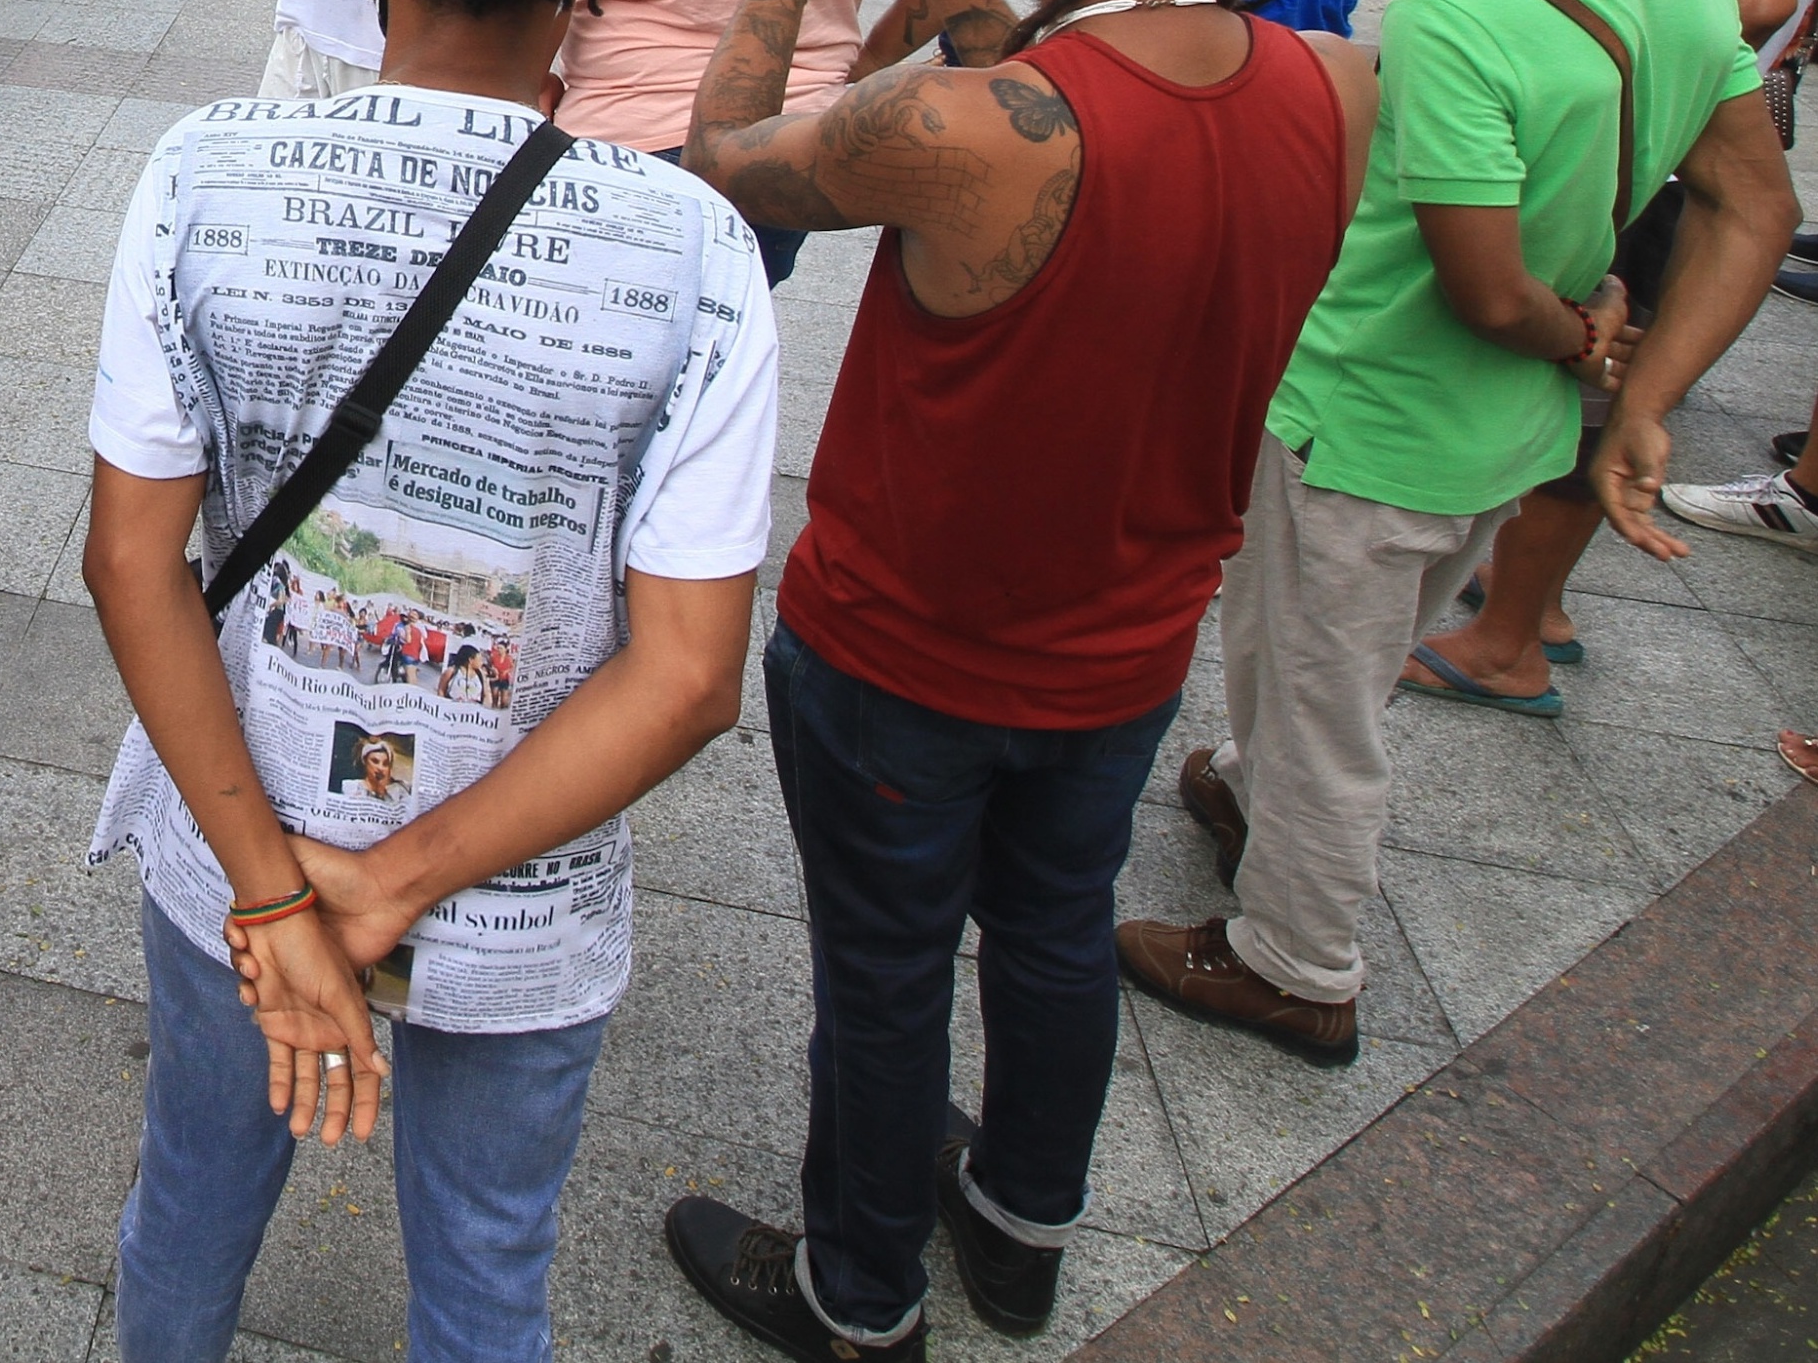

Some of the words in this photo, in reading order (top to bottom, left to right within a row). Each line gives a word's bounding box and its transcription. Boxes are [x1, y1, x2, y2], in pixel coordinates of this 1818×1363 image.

[199, 94, 422, 127] BRAZIL
[456, 108, 646, 177] LIRE
[268, 140, 386, 181] GAZETA
[399, 154, 439, 189] DE
[449, 162, 600, 214] NOCIAS
[282, 196, 425, 239] BRAZIL
[192, 227, 244, 249] 1888
[609, 287, 670, 314] 1888
[315, 236, 398, 263] TREZE
[408, 248, 445, 268] DE
[478, 262, 528, 287] AIO
[264, 257, 382, 287] EXTINCÇÃO
[394, 271, 421, 291] DA
[464, 285, 580, 325] CRAVIDÃO
[211, 285, 247, 298] LEI
[248, 290, 274, 302] N.
[282, 294, 335, 308] 3353
[343, 296, 376, 310] DE
[385, 300, 409, 312] 13
[462, 315, 528, 341] MAIO
[538, 334, 574, 351] DE
[580, 342, 634, 360] 1888
[256, 340, 299, 354] declarada
[209, 311, 218, 320] A
[264, 319, 303, 332] Imperial
[435, 336, 487, 357] Magestade
[503, 354, 555, 375] Imperador
[573, 369, 588, 382] Sr.
[591, 373, 603, 384] D.
[606, 376, 636, 388] Pedro
[449, 349, 477, 364] Geral
[419, 377, 485, 401] conhecimento
[392, 452, 472, 489] Mercado
[474, 475, 498, 496] de
[500, 484, 577, 510] trabalho
[421, 433, 484, 458] PRINCEZA
[487, 450, 544, 475] IMPERIAL
[547, 464, 610, 485] REGENTE
[388, 473, 400, 492] é
[402, 479, 483, 516] desigual
[485, 505, 525, 530] com
[528, 511, 588, 537] negros
[267, 654, 299, 688] From
[300, 674, 328, 695] Rio
[329, 681, 377, 712] official
[378, 694, 394, 711] to
[396, 693, 442, 720] global
[442, 706, 501, 731] symbol
[533, 663, 571, 680] NEGROS
[546, 859, 561, 877] NO
[464, 904, 555, 937] symbol
[470, 940, 524, 957] oppression
